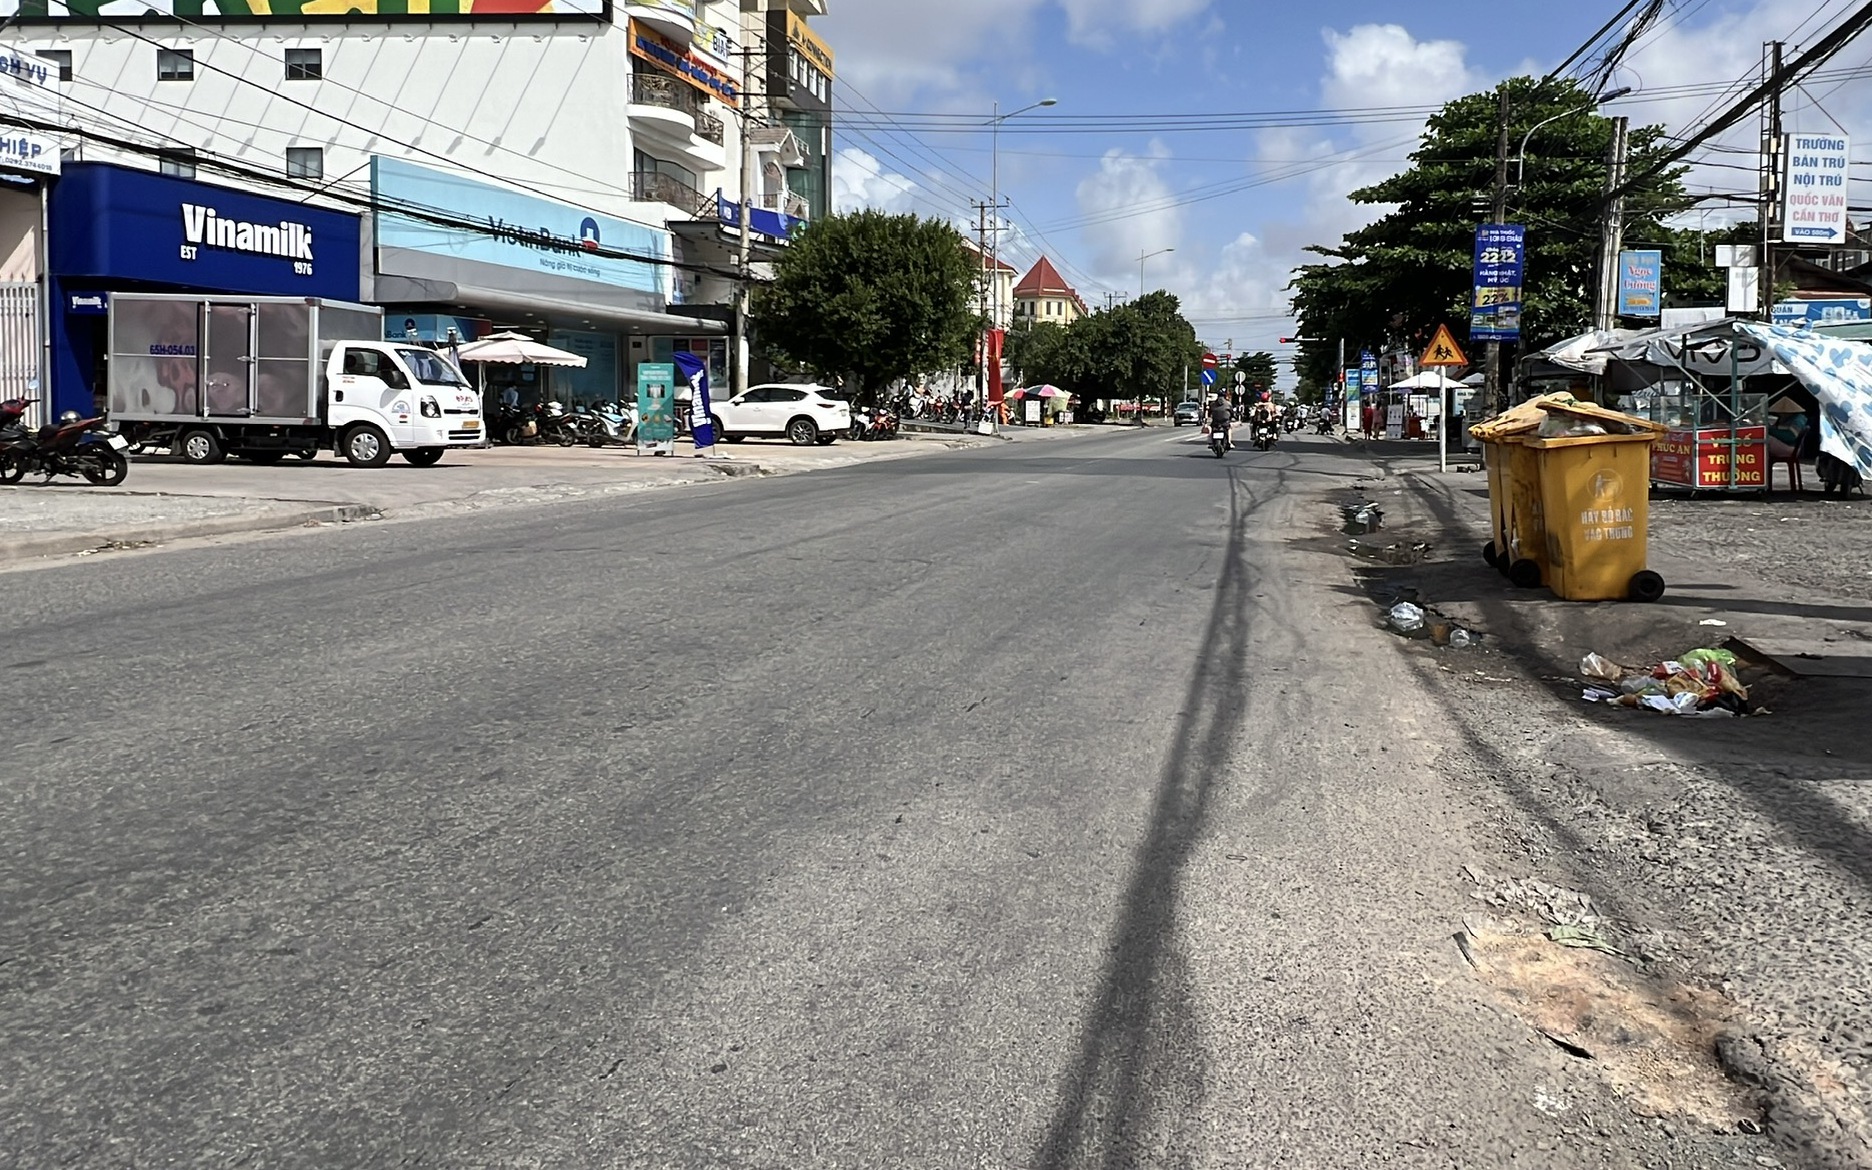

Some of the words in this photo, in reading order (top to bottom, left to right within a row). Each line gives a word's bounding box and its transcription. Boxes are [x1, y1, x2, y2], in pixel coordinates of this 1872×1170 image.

[1796, 137, 1845, 151] TRƯỜNG
[1822, 155, 1845, 168] TRÚ
[1794, 172, 1815, 187] NỘI
[1819, 173, 1842, 186] TRÚ
[1790, 192, 1819, 206] QUỐC
[1819, 210, 1840, 222] THƠ
[182, 203, 313, 260] Vinamilk
[181, 245, 197, 260] EST
[294, 261, 313, 275] 1976
